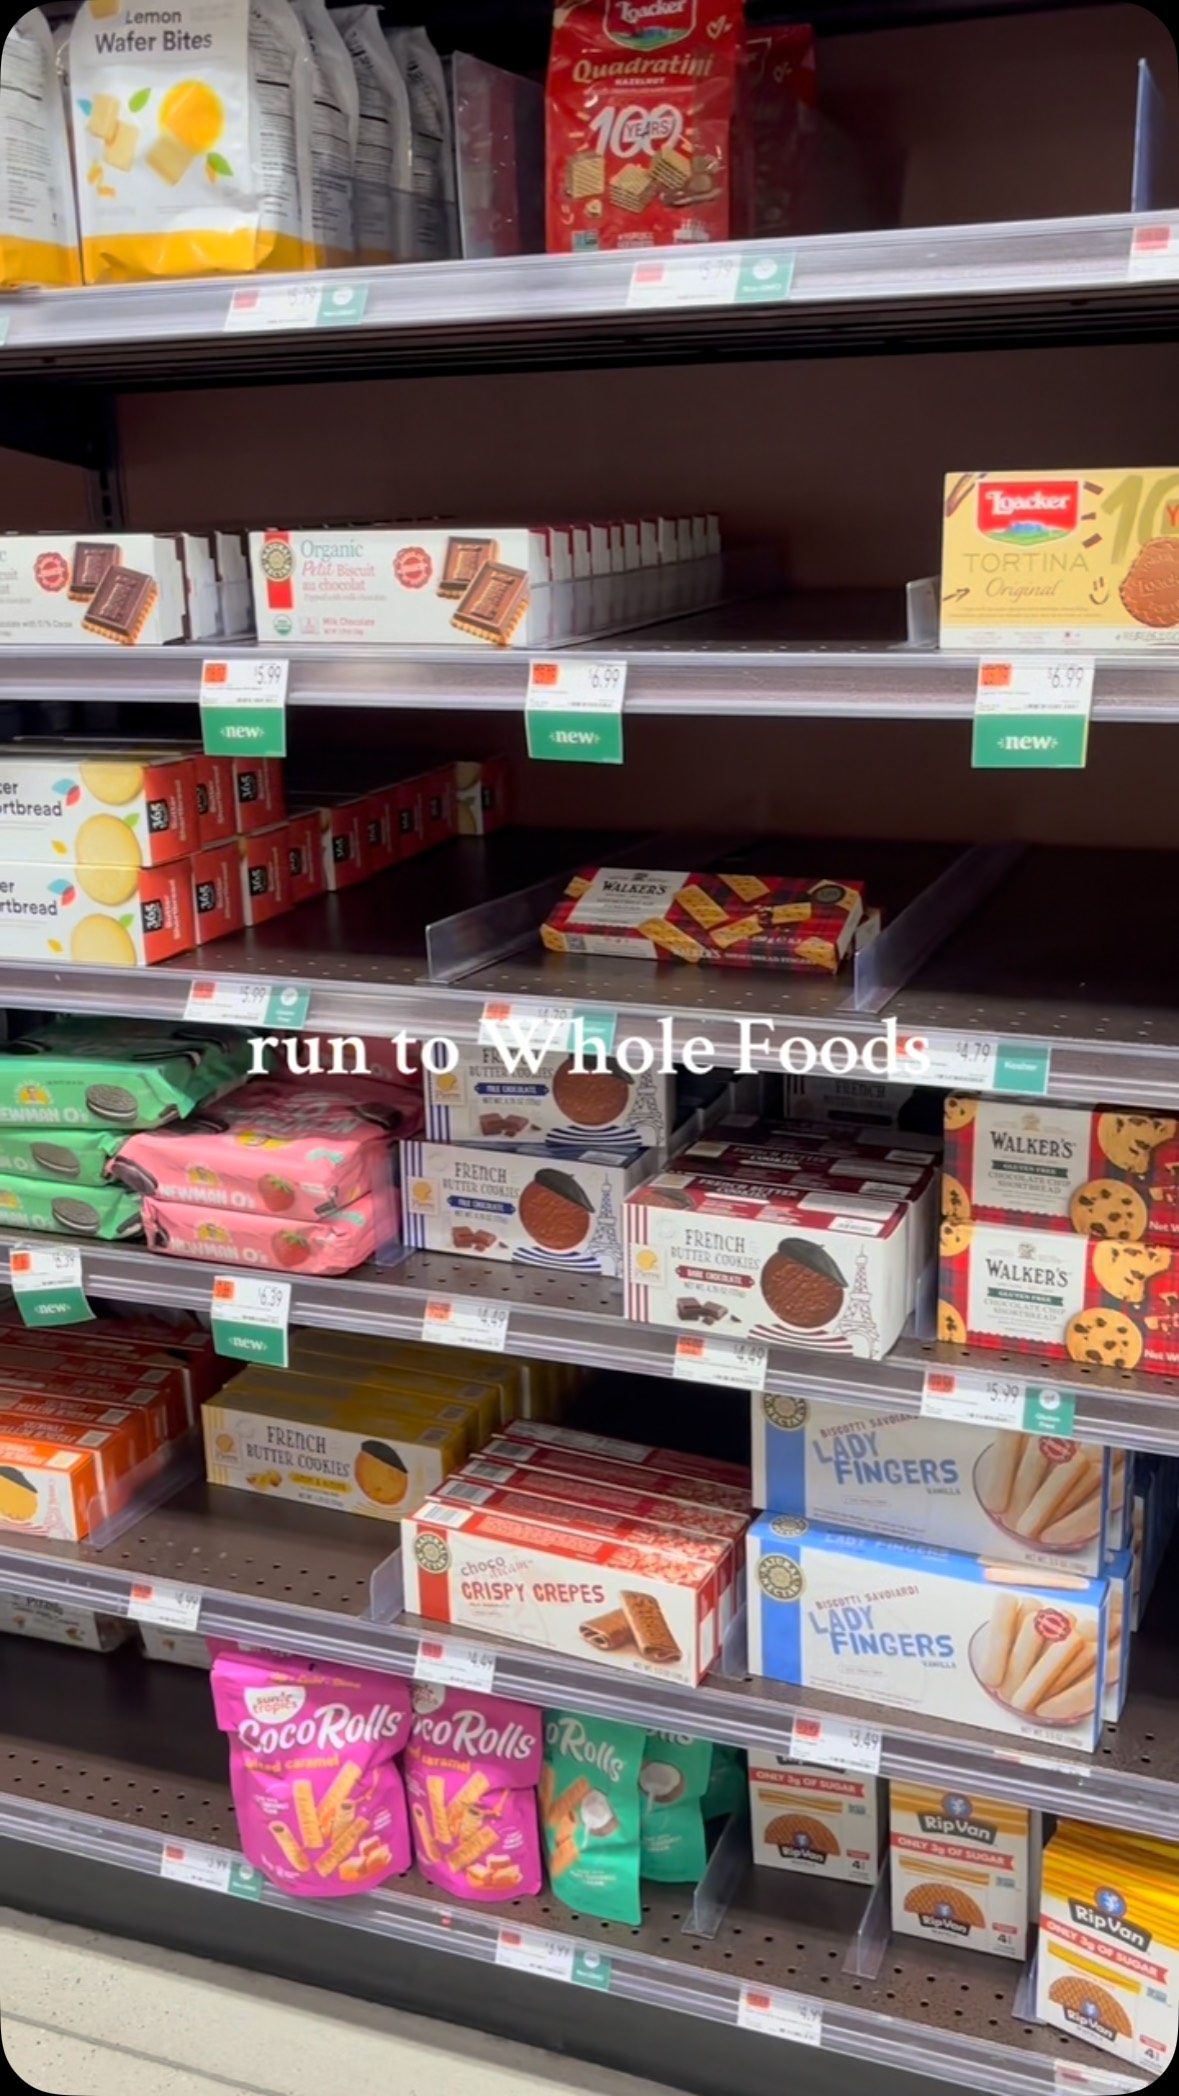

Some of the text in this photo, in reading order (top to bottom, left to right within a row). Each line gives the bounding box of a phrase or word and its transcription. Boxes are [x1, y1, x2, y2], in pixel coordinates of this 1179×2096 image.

[125, 9, 182, 25] Lemon
[95, 30, 213, 54] Wafer Bites
[572, 54, 715, 83] Quadratini
[626, 118, 669, 139] YEARS
[985, 490, 1071, 516] Loacker
[300, 539, 364, 562] Organic
[302, 560, 336, 577] Petit
[337, 562, 376, 577] Biscuit
[962, 553, 1090, 574] TORTINA
[302, 578, 366, 592] au chocolat
[985, 578, 1063, 604] Original
[225, 725, 260, 739] new
[555, 730, 596, 745] new
[1004, 735, 1052, 751] new
[149, 802, 165, 830] 365
[144, 903, 158, 930] 365
[956, 1040, 991, 1064] $4.79
[989, 1130, 1074, 1160] WALKER'S
[454, 1161, 508, 1184] FRENCH
[442, 1178, 521, 1199] BUTTER COOKIES
[685, 1228, 746, 1254] FRENCH
[671, 1245, 761, 1271] BUTTER COOKIES
[985, 1258, 1069, 1288] WALKER'S
[266, 1425, 327, 1455] FRENCH
[819, 1422, 867, 1439] BISCOTTI
[811, 1430, 880, 1464] LADY
[246, 1443, 350, 1478] BUTTER COOKIES
[833, 1458, 959, 1485] FINGERS
[460, 1556, 506, 1577] choco
[460, 1580, 606, 1604] CRISPY CREPES
[815, 1584, 921, 1611] BISCOTTI SAVOIARDI
[807, 1604, 876, 1635] LADY
[829, 1631, 956, 1658] FINGERS
[284, 1753, 340, 1770] caramel
[755, 1771, 784, 1782] ONLY
[802, 1777, 818, 1787] OF
[819, 1780, 857, 1794] SUGAR
[897, 1837, 1005, 1865] ONLY 3g OF SUGAR
[852, 1860, 861, 1869] 4
[997, 1933, 1007, 1944] 4
[1046, 1920, 1159, 1978] ONLY 3g OF SUGAR
[1144, 2048, 1154, 2060] 4
